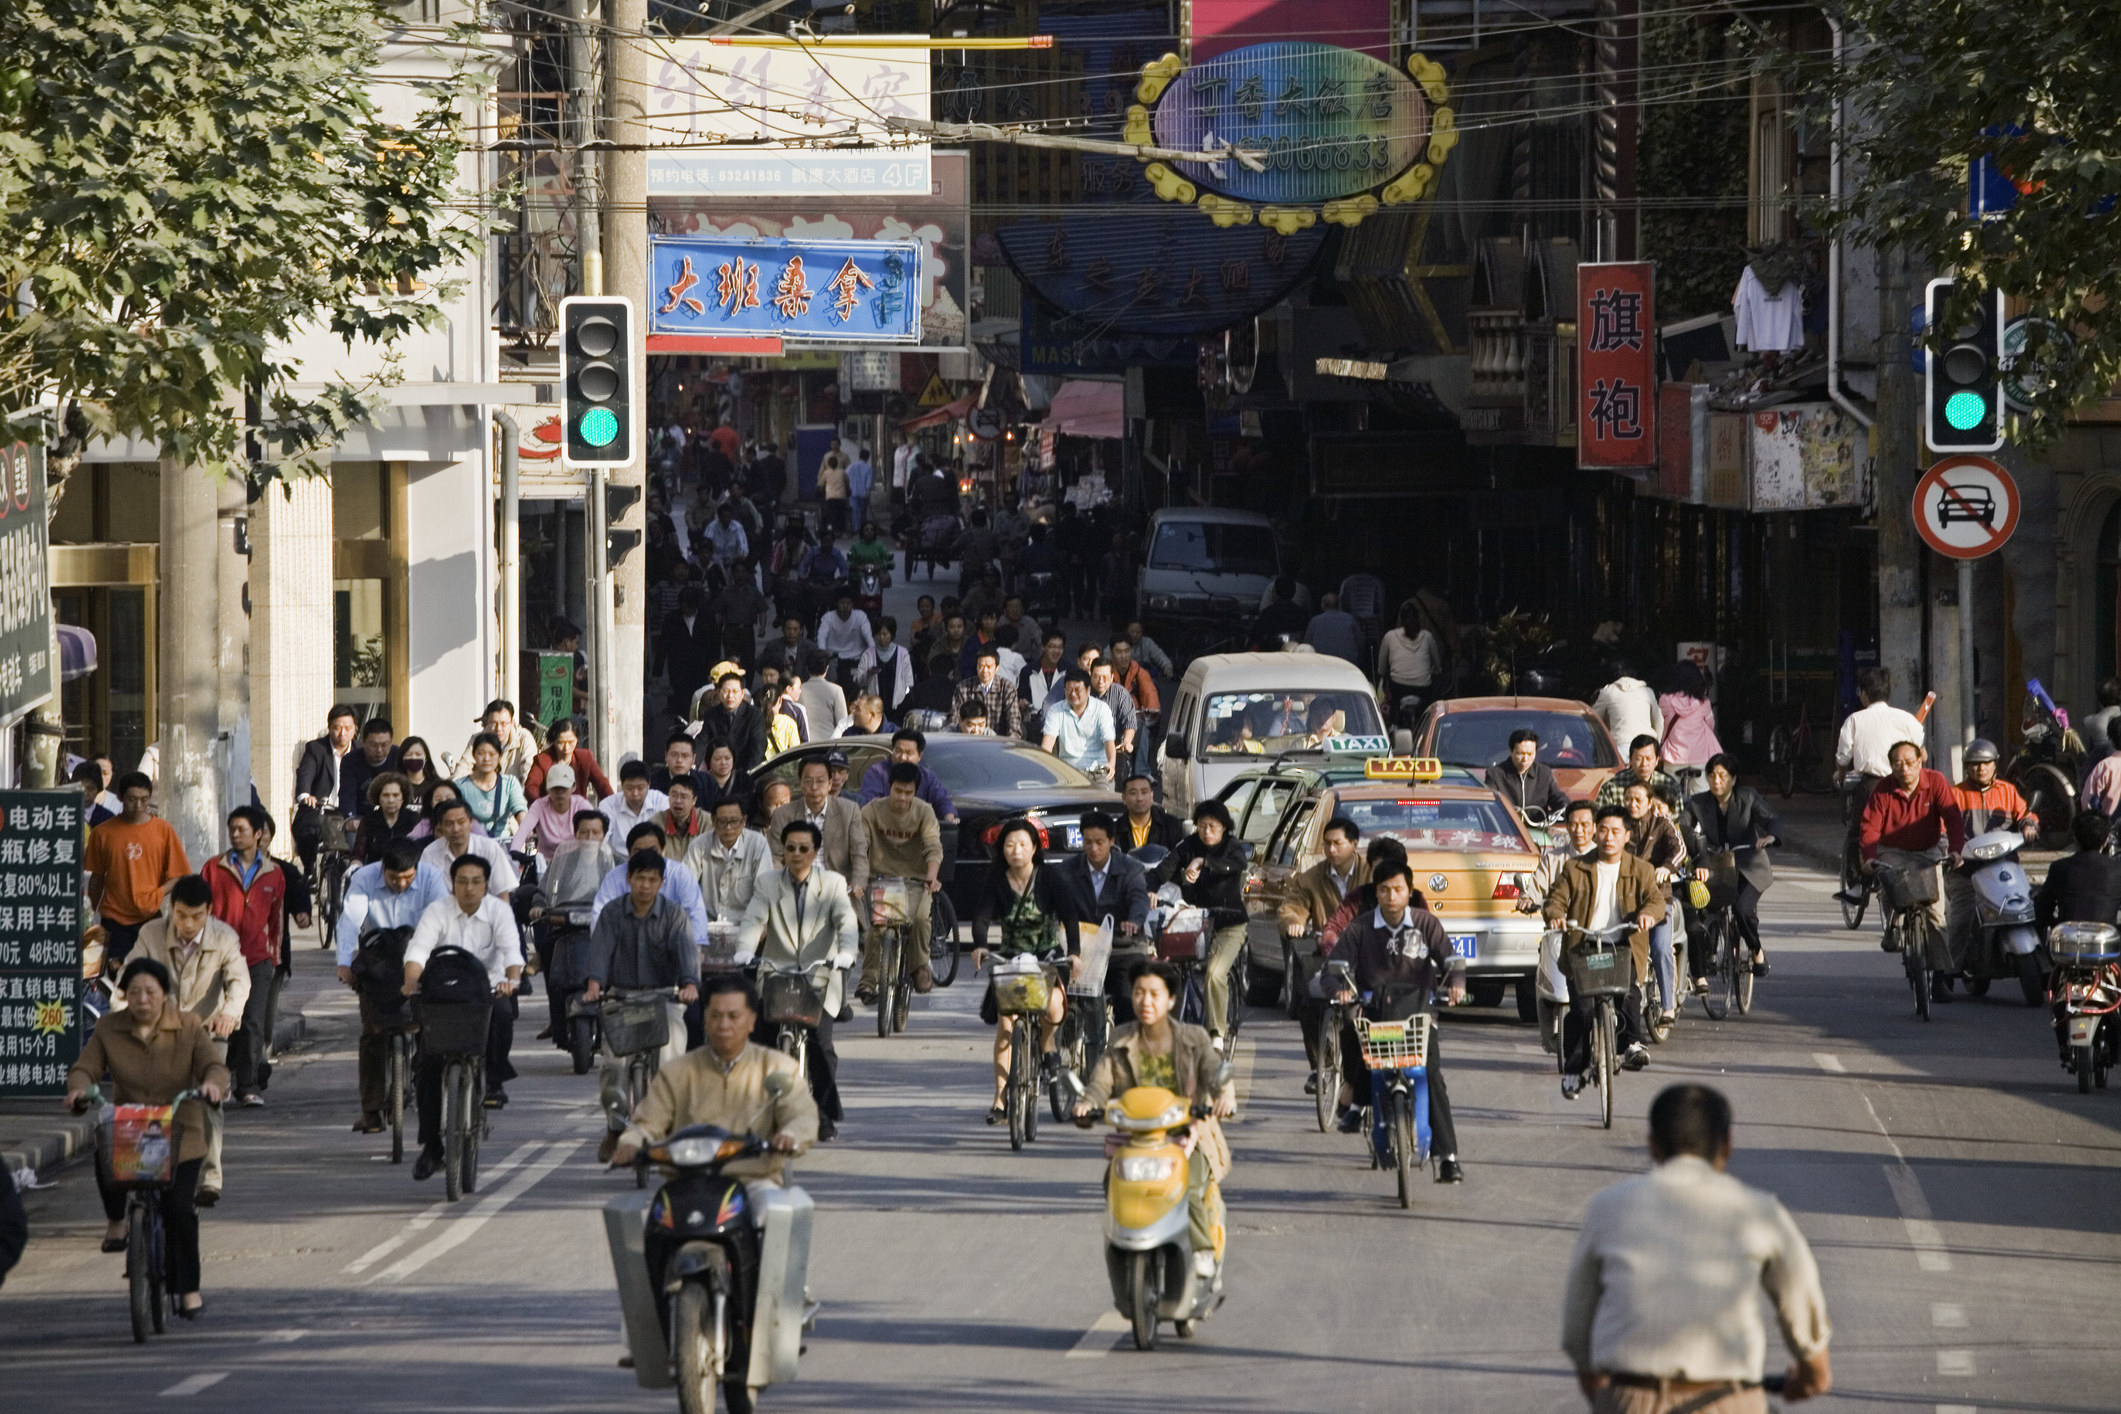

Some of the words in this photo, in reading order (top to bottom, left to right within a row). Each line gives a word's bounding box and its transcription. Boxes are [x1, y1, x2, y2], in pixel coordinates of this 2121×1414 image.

[719, 169, 782, 182] 63241836
[882, 163, 924, 188] 4F
[661, 255, 875, 322] 大班桑拿
[1588, 288, 1644, 441] 旗袍
[1335, 737, 1386, 750] TAXI
[1379, 760, 1430, 772] TAXI
[9, 804, 77, 831] 电动车
[0, 872, 76, 898] 复80%以上
[29, 939, 77, 965] 48伏90元
